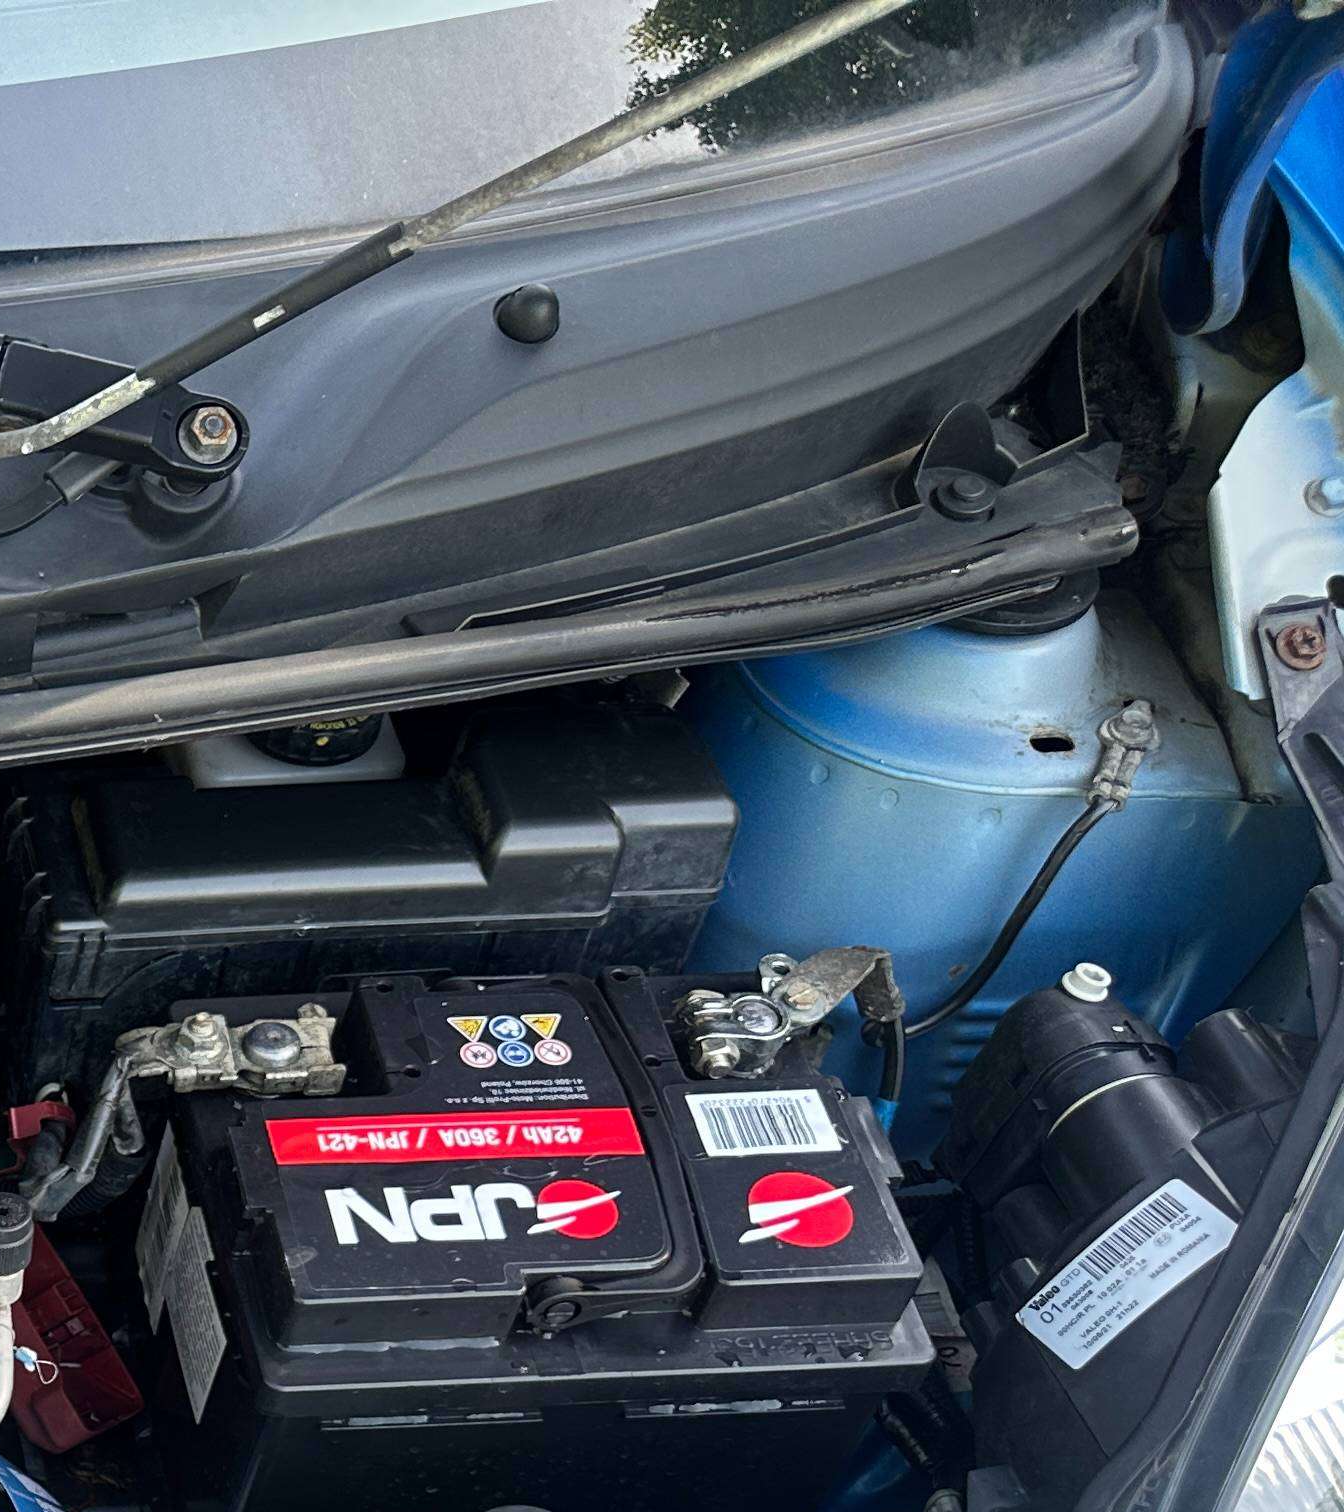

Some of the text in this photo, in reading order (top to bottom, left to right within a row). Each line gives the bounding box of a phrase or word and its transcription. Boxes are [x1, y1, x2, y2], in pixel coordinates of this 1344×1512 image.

[316, 1129, 408, 1150] JPN-421
[438, 1126, 501, 1146] 360A
[522, 1125, 583, 1144] 42Ah
[323, 1181, 538, 1246] JPN
[1177, 1232, 1211, 1259] ROMANIA
[1028, 1285, 1062, 1312] Valeo
[1039, 1302, 1064, 1325] 01
[1079, 1313, 1108, 1339] VALEO
